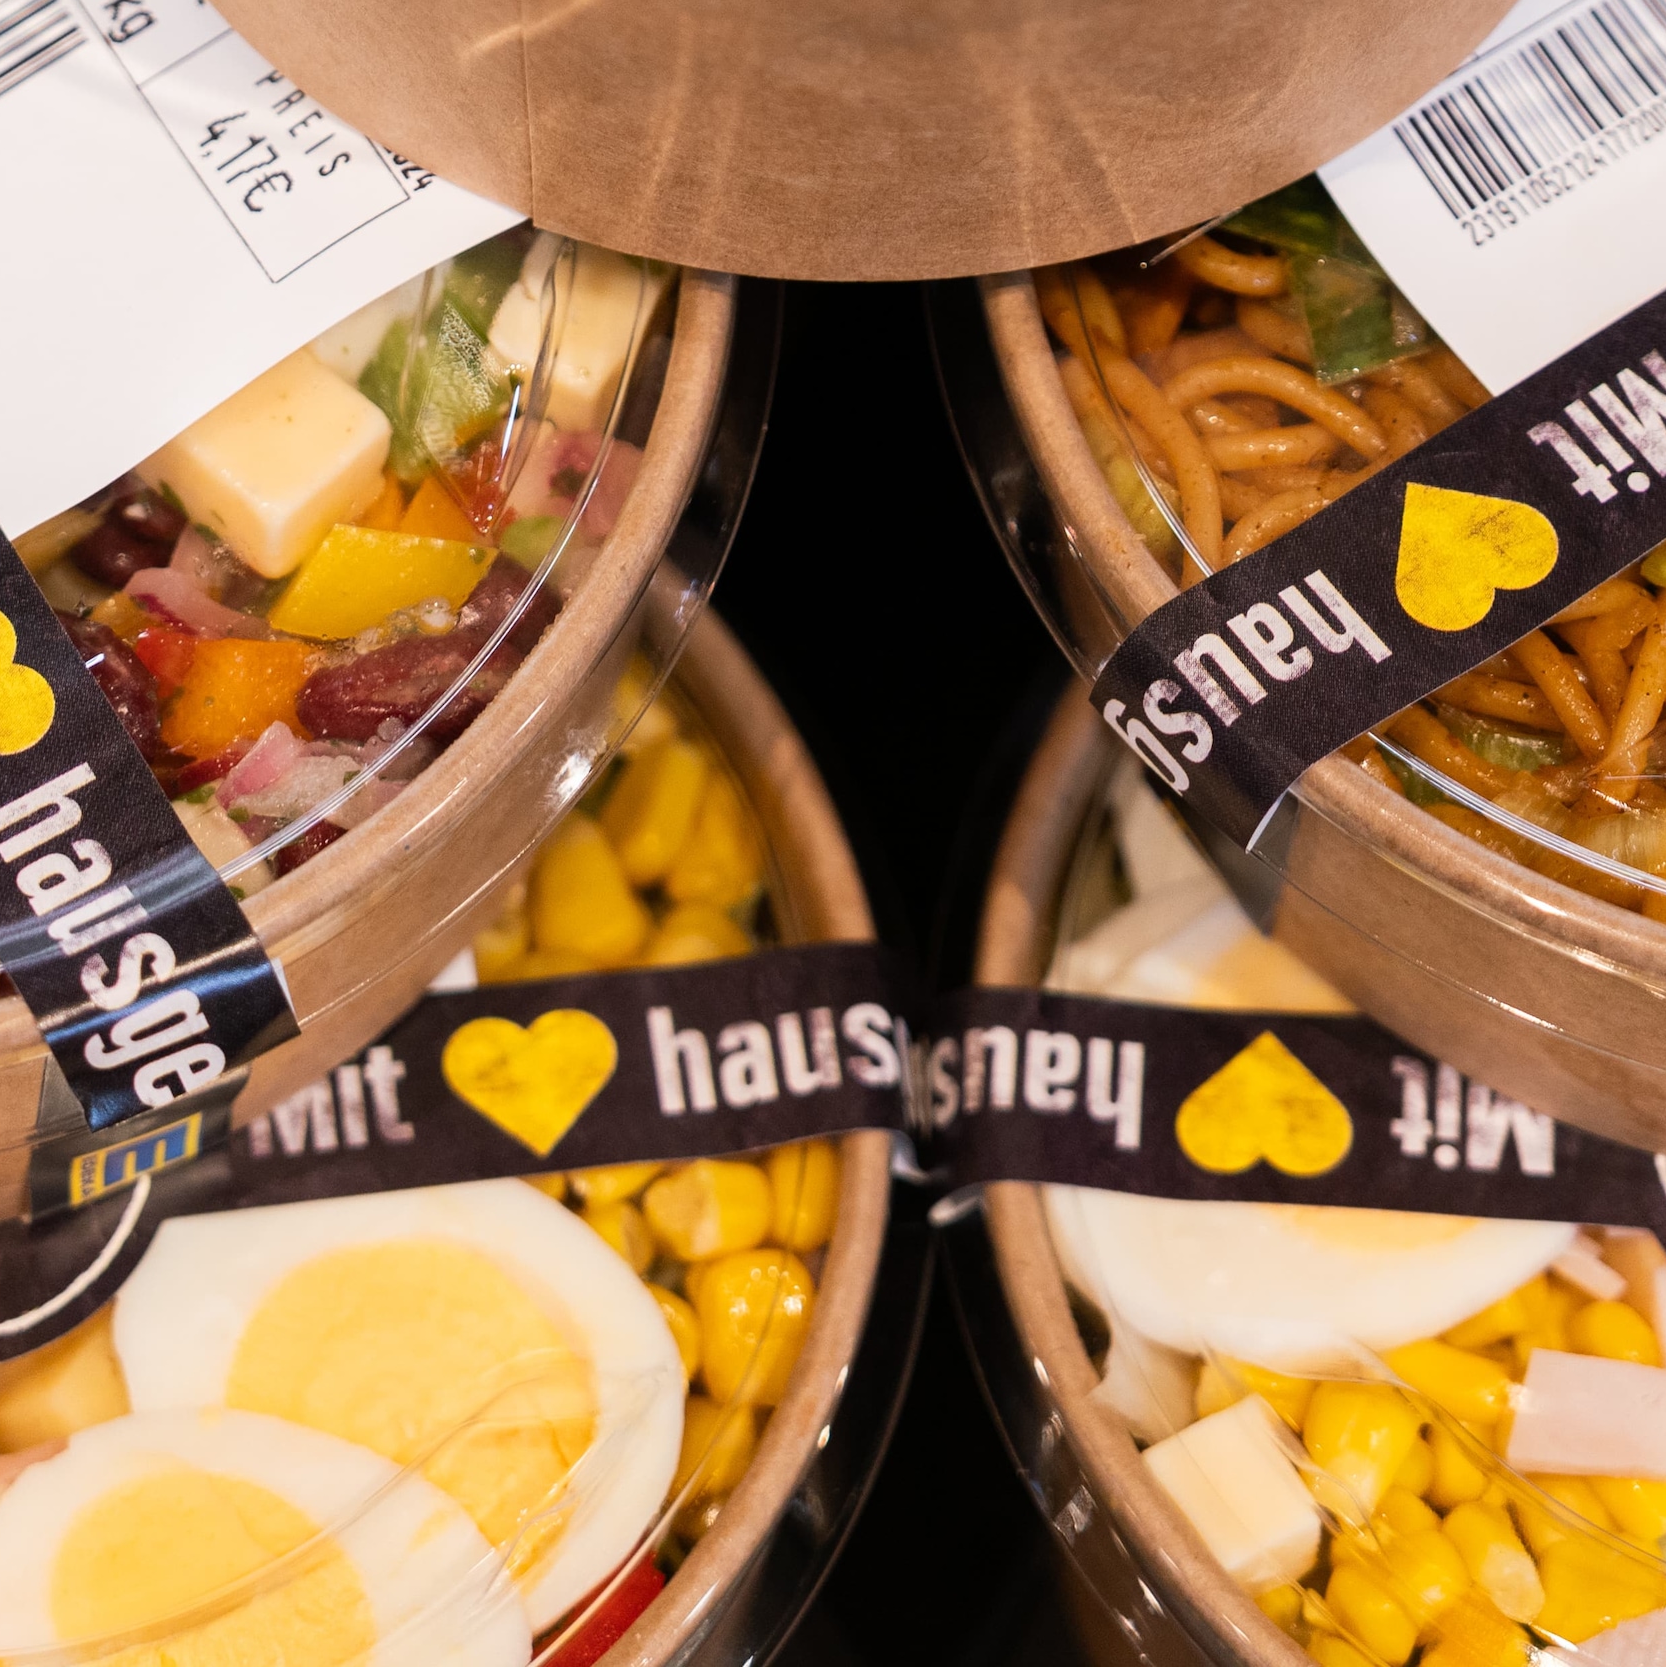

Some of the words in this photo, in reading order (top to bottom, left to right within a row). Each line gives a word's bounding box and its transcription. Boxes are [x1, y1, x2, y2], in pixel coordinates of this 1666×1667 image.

[196, 110, 295, 214] 4,17€
[646, 1000, 915, 1128] haus
[909, 1022, 1145, 1152] haus
